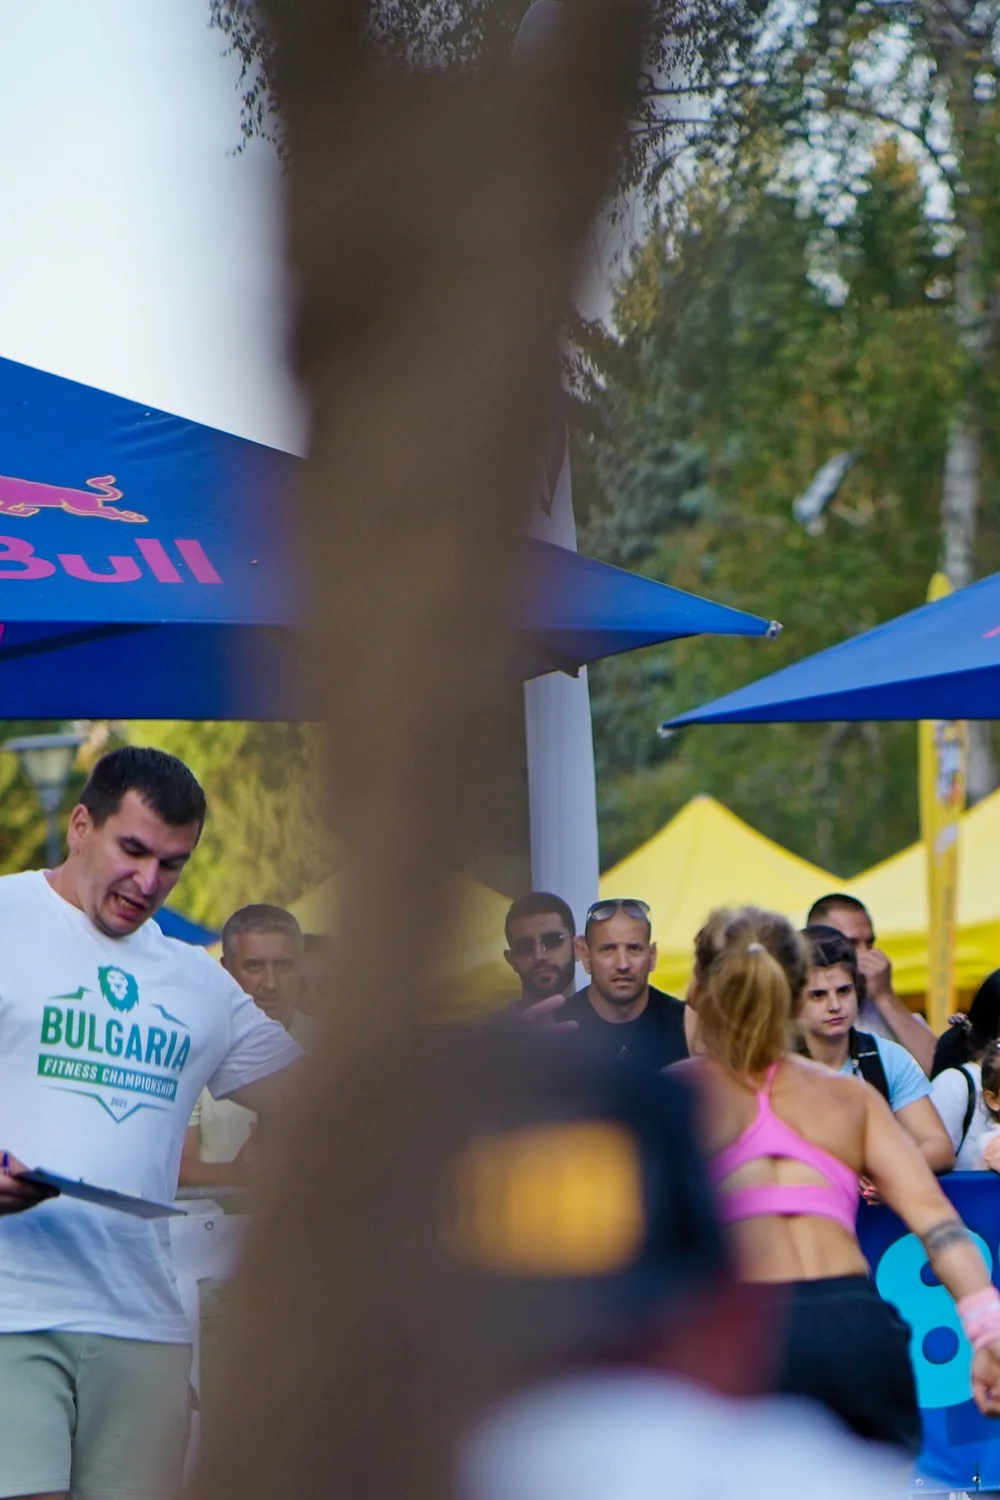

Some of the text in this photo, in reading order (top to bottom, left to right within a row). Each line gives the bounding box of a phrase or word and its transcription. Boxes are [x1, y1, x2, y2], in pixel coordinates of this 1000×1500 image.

[41, 1005, 191, 1073] BULGARIA
[44, 1058, 175, 1097] FITNESS CHAMPIONSHIP
